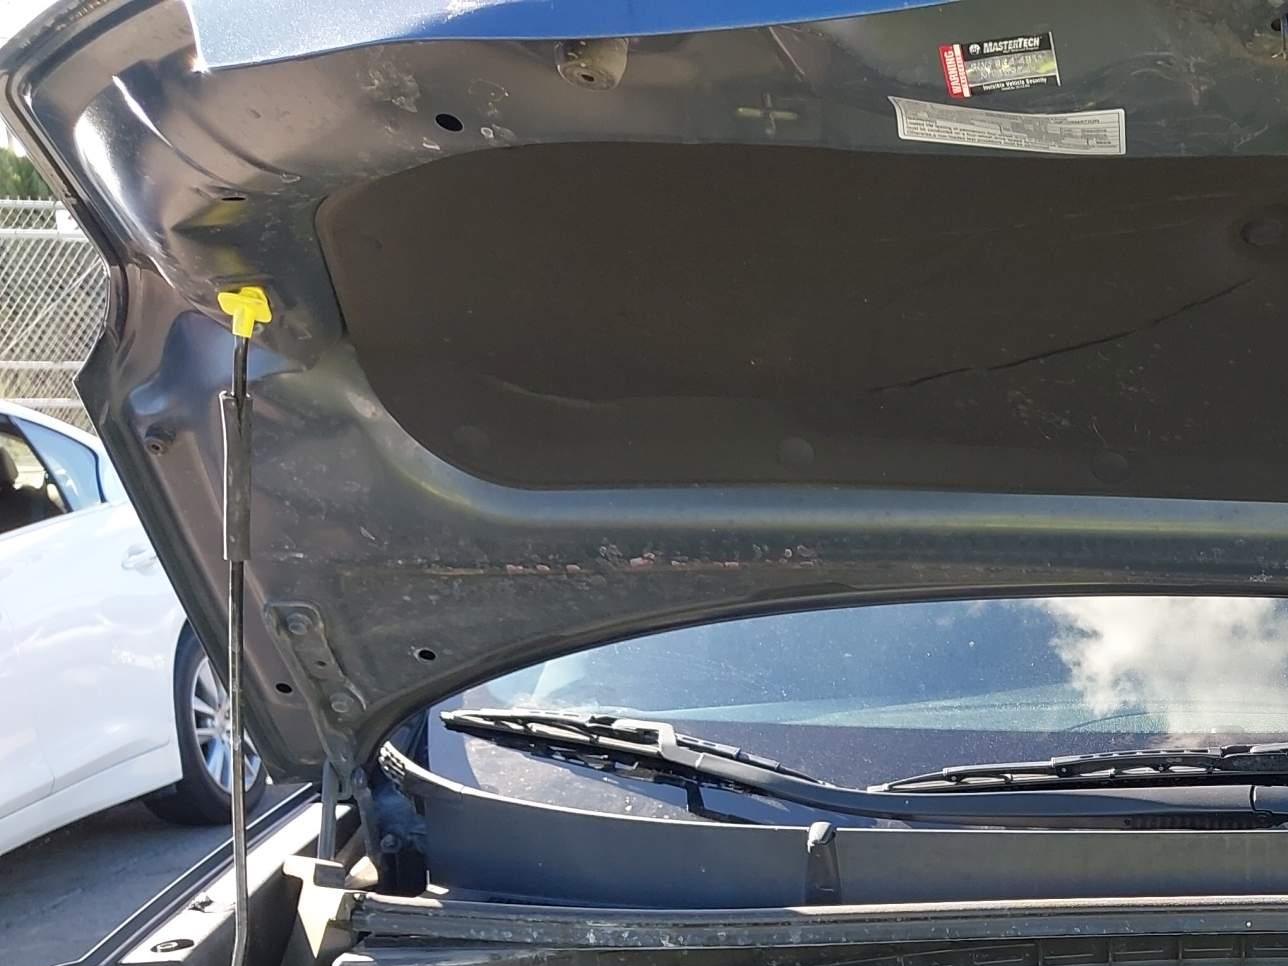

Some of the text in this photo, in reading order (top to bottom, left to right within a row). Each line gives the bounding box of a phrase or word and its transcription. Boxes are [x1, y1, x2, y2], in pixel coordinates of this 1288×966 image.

[944, 50, 963, 94] WARNING
[982, 82, 1005, 92] Invisible
[1005, 79, 1025, 89] Vehicle
[1025, 77, 1047, 87] Security
